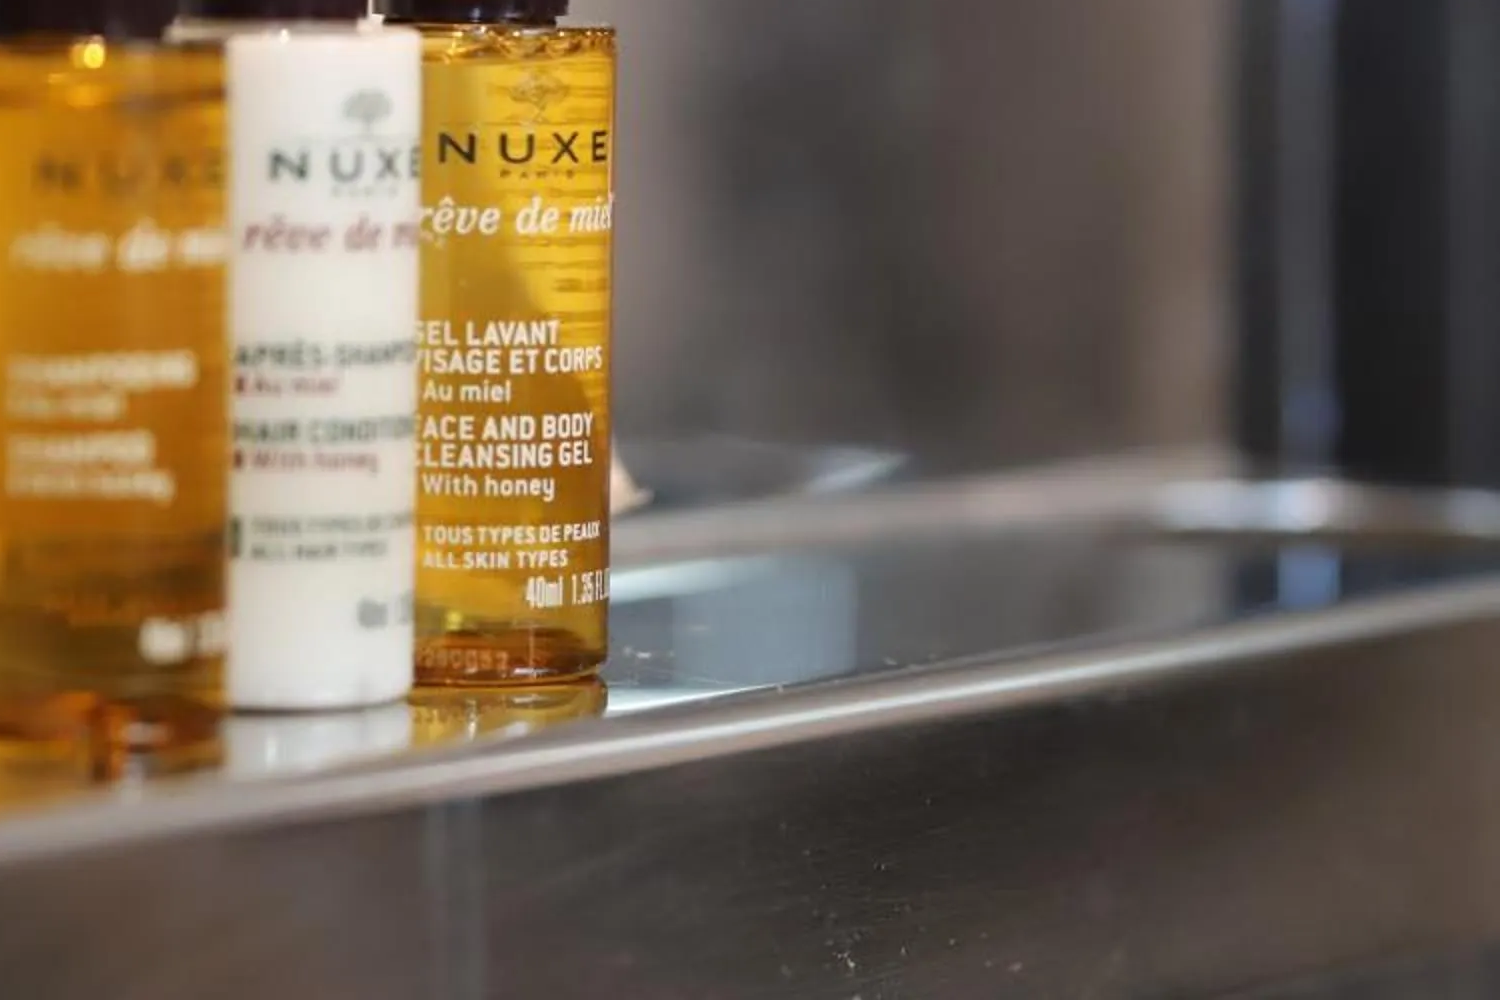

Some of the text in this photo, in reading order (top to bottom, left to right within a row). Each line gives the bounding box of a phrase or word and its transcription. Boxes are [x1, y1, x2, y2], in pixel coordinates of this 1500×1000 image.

[438, 130, 608, 164] NUXE
[515, 196, 561, 235] de
[569, 192, 614, 233] miel
[343, 212, 383, 253] de
[466, 319, 560, 346] LAVANT
[509, 348, 540, 375] ET
[544, 346, 602, 375] CORPS
[422, 379, 512, 403] Au miel
[482, 414, 536, 441] AND
[542, 412, 593, 441] BODY
[558, 440, 593, 467] GEL
[422, 473, 556, 503] With honey
[422, 519, 601, 545] TOUS TYPES DE PEAUX
[422, 548, 569, 570] ALL SKIN TYPES
[526, 575, 564, 609] 40ml
